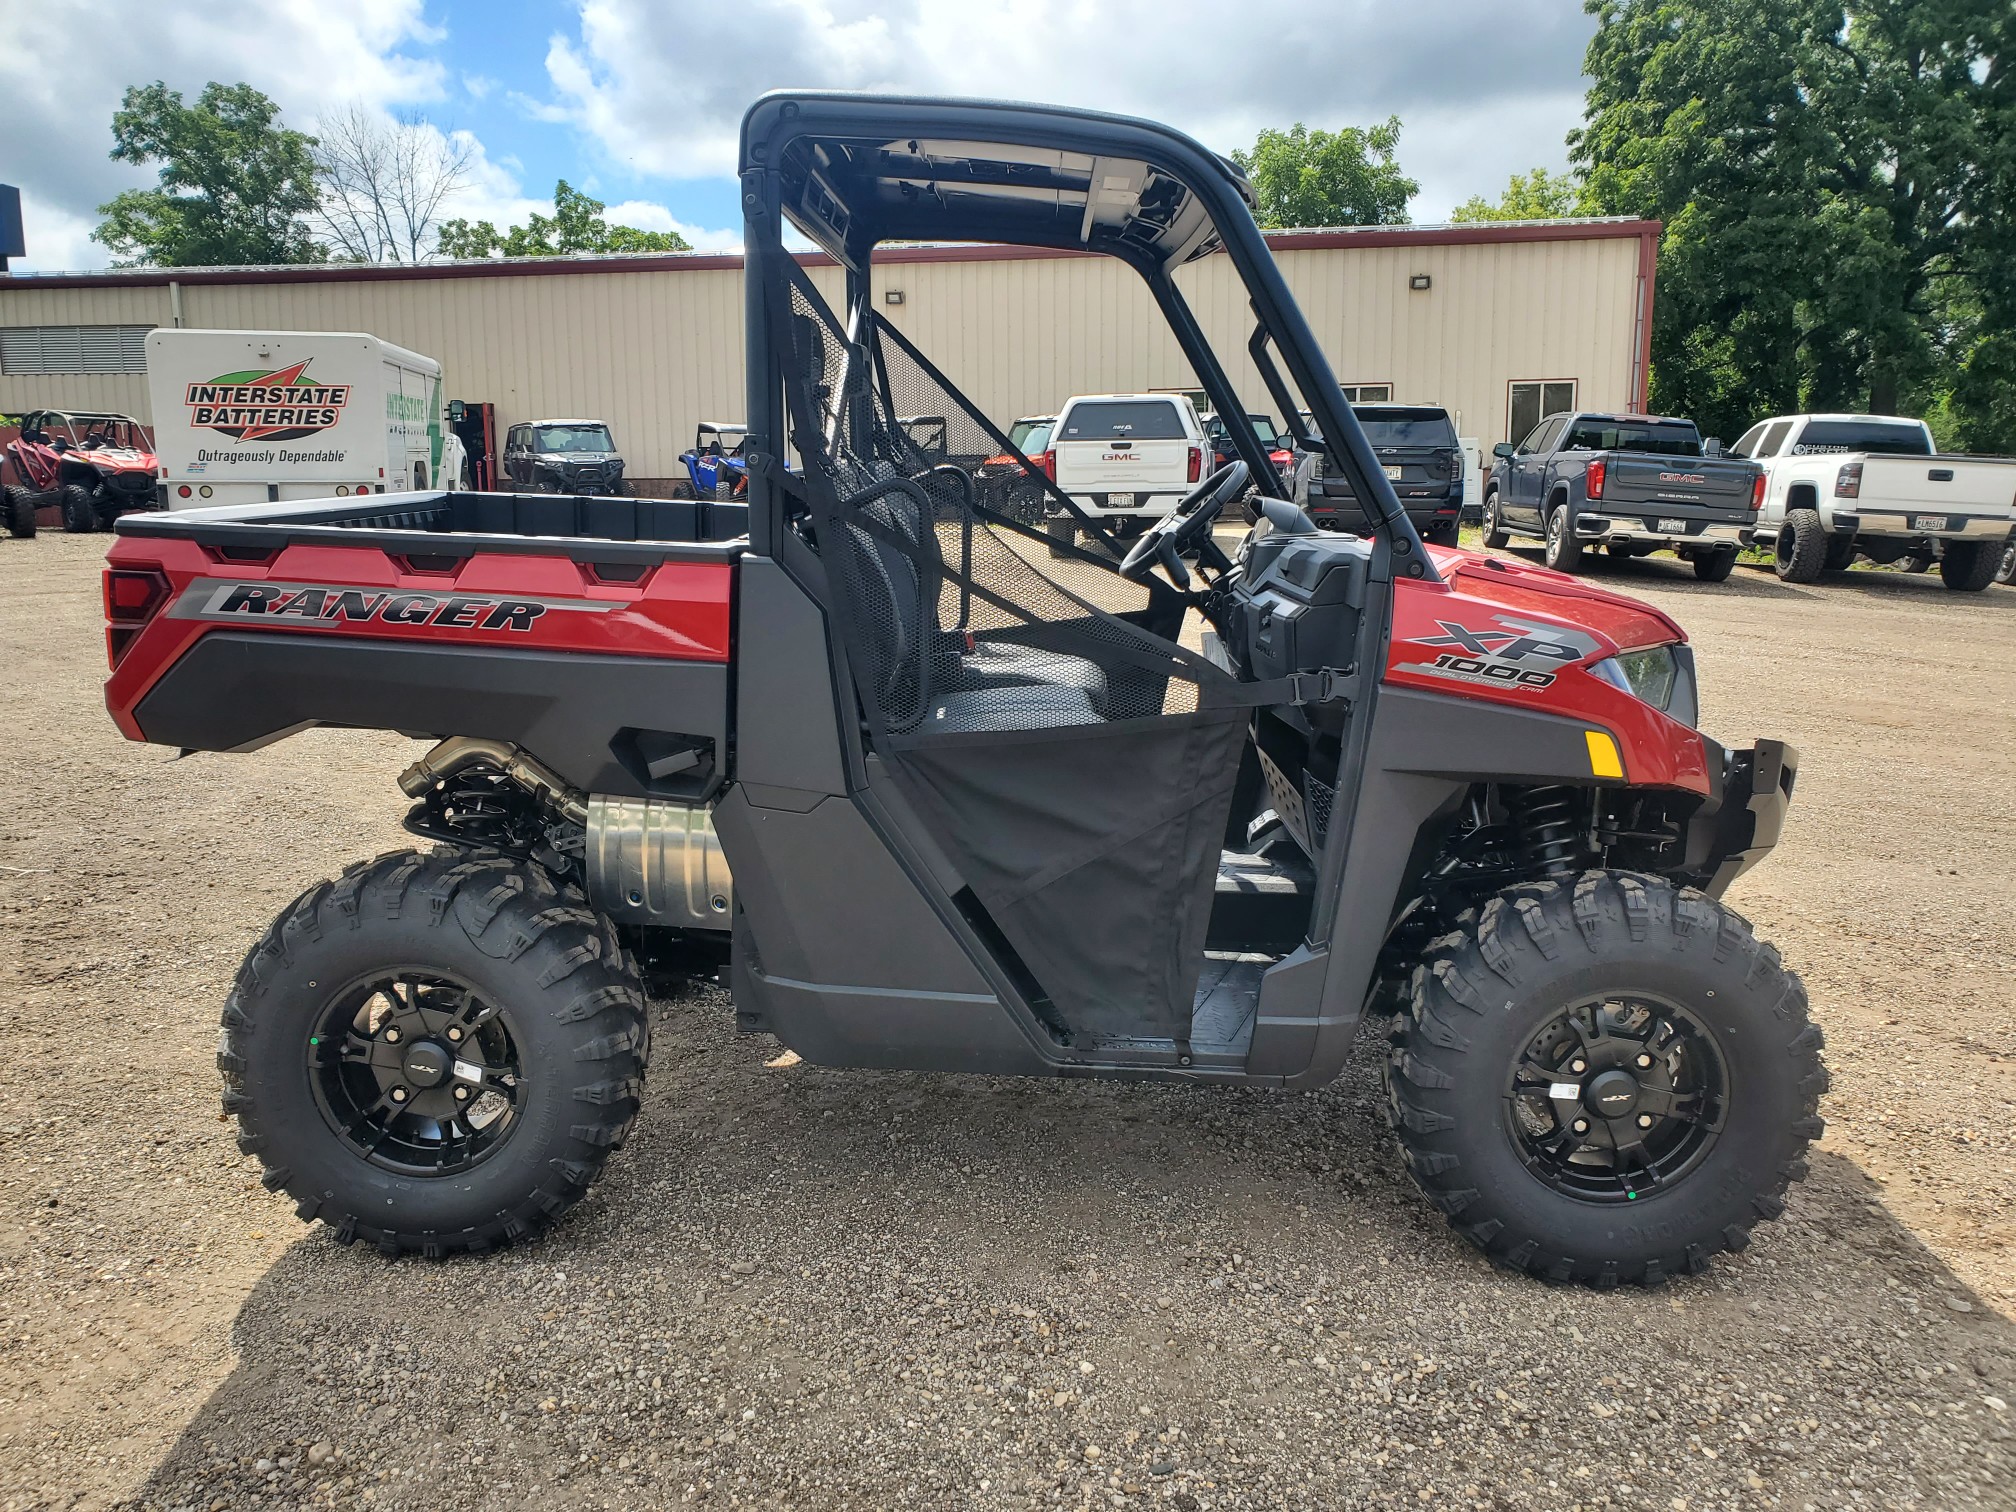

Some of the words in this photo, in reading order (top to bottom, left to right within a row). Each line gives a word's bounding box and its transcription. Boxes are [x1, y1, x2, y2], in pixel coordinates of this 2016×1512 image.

[189, 386, 345, 404] INTERSTATE
[195, 408, 335, 425] BATTERIES
[198, 449, 275, 465] Outrageously
[1102, 453, 1141, 461] GMC
[1659, 472, 1705, 484] GMC
[218, 584, 547, 632] RANGER
[1402, 619, 1585, 662] XP
[1433, 654, 1557, 688] 1000
[1429, 669, 1458, 678] DUAL
[1519, 685, 1545, 694] CAM
